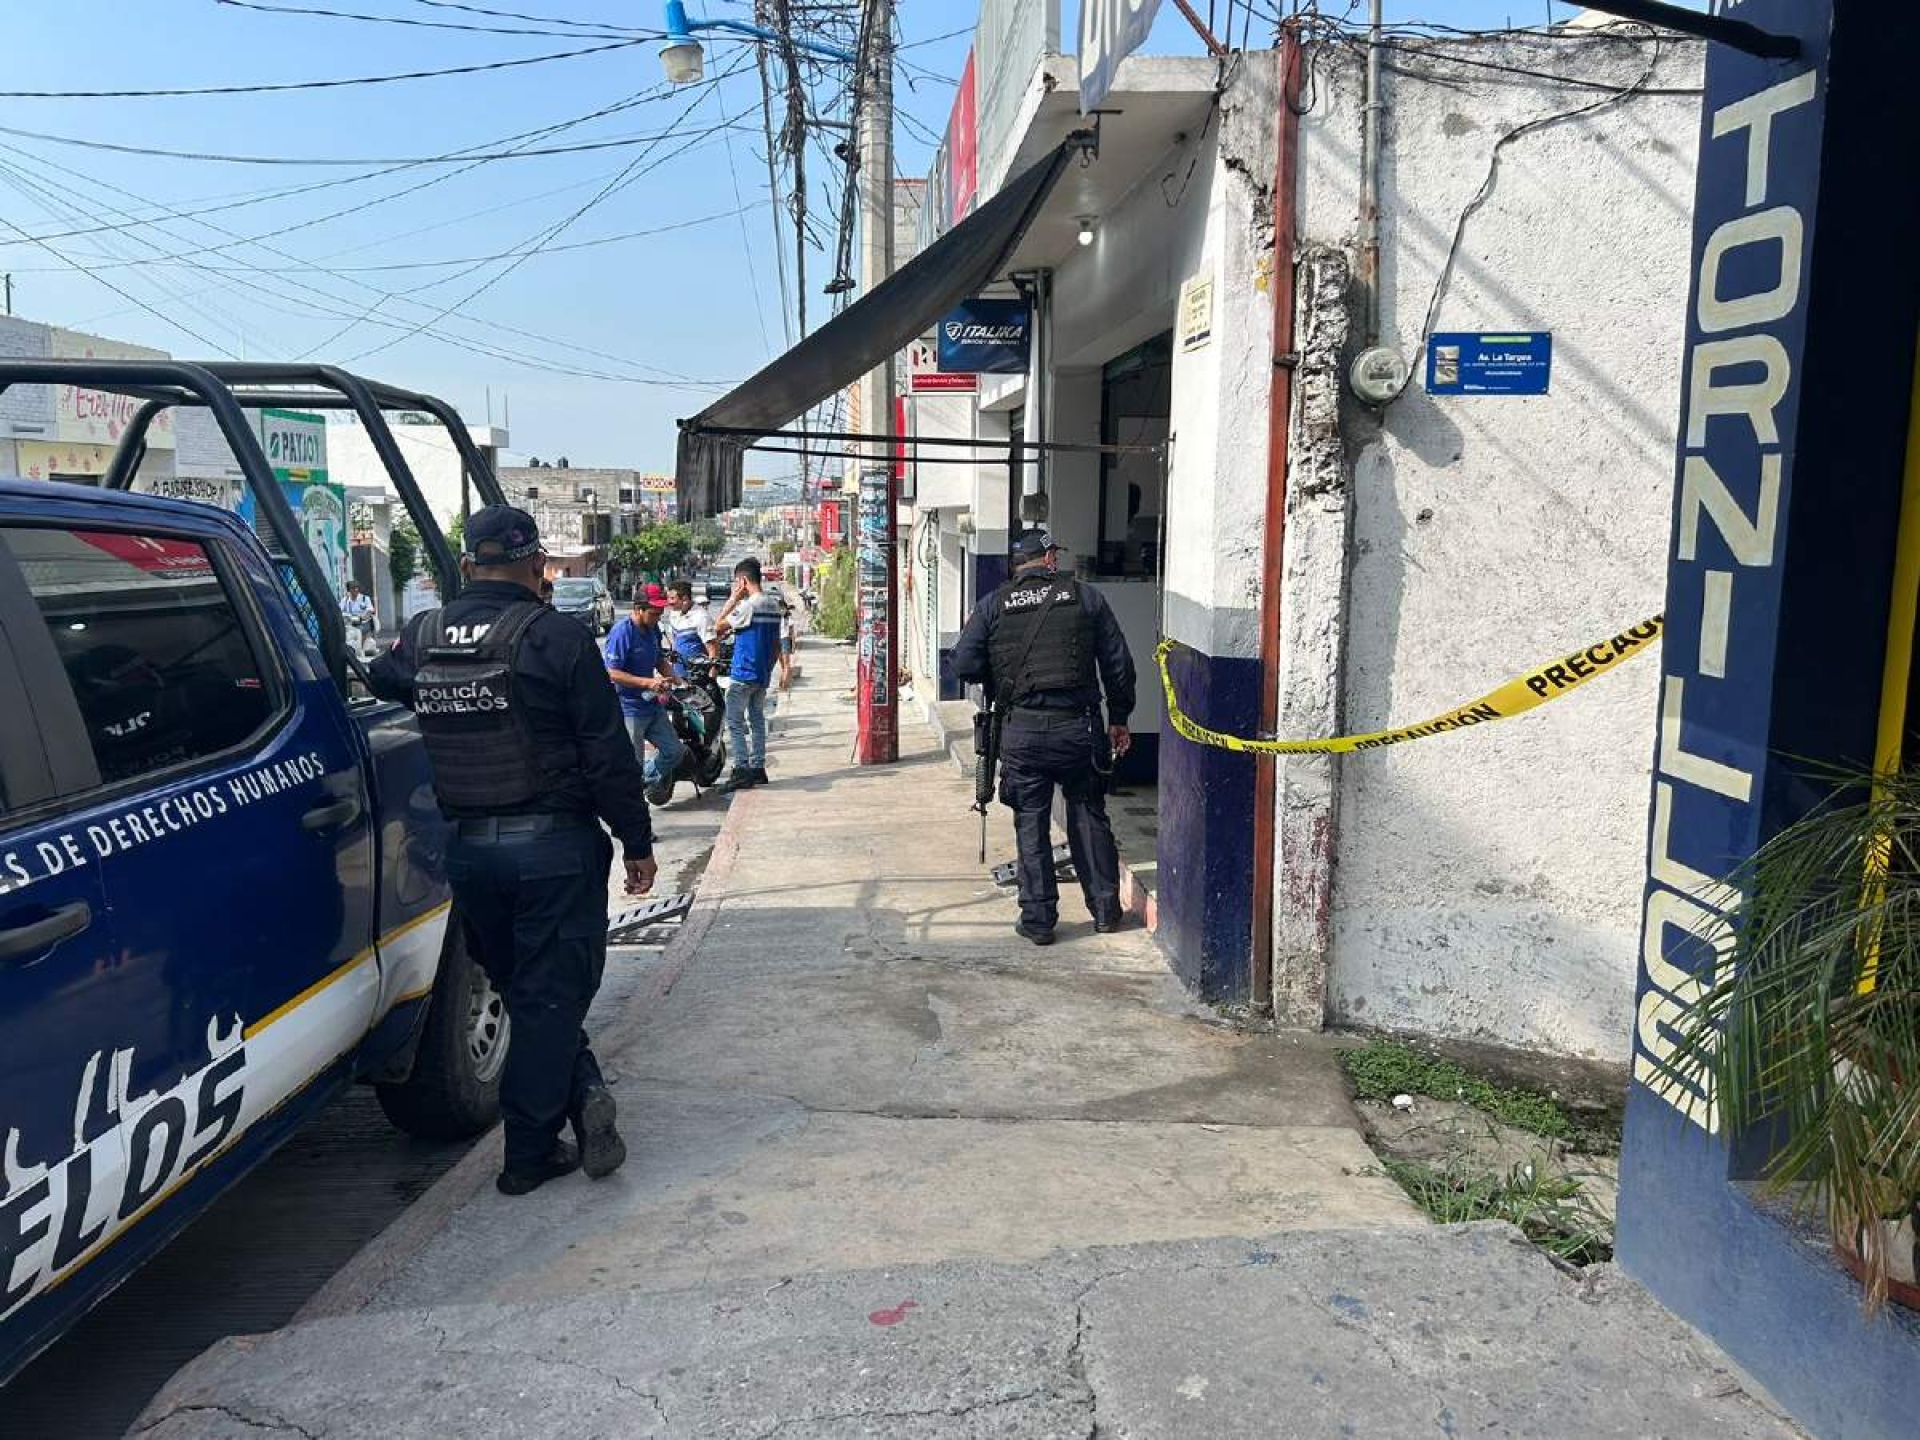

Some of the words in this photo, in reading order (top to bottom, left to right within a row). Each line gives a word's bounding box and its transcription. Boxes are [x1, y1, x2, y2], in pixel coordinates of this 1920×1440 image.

[962, 325, 1023, 338] ITALIKA
[282, 431, 320, 463] PAYJOY
[1010, 584, 1052, 600] POLIC
[1634, 69, 1817, 1134] TORNILLOS
[1526, 614, 1664, 697] PRECAU
[418, 681, 493, 700] POLICÍA
[414, 697, 508, 715] MORELOS
[36, 833, 87, 876] DE
[87, 785, 227, 858] DERECHOS
[227, 751, 325, 806] HUMANOS
